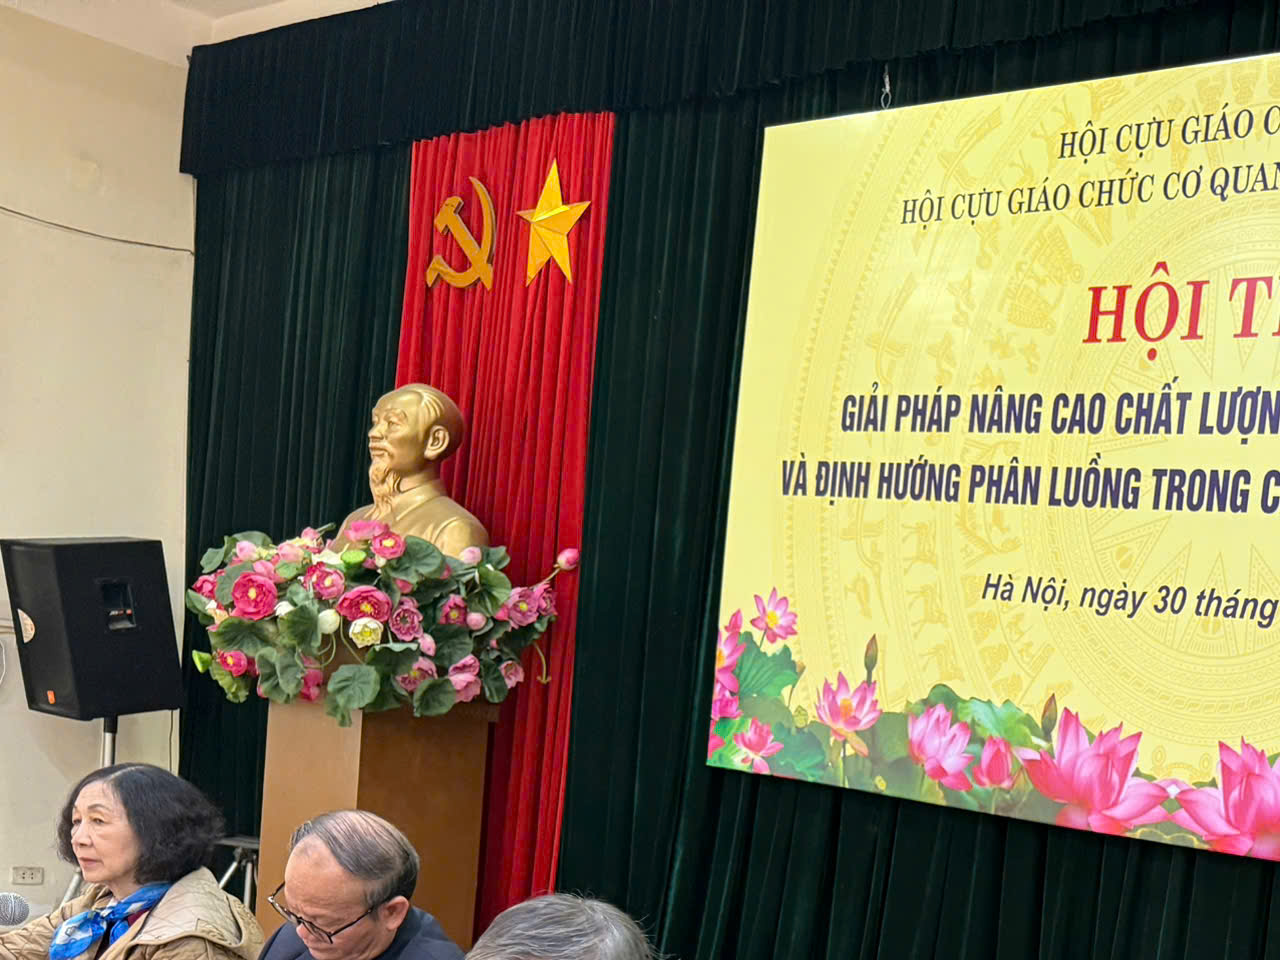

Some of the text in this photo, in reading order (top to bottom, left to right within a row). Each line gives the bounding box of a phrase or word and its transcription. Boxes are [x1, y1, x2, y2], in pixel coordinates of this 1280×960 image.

[1058, 120, 1108, 164] HỘI
[1116, 117, 1174, 158] CỰU
[1182, 103, 1253, 144] GIÁO
[901, 190, 944, 229] HỘI
[952, 188, 1002, 225] CỰU
[1008, 177, 1070, 214] GIÁO
[1079, 168, 1154, 208] CHỨC
[1163, 165, 1203, 200] CƠ
[1083, 261, 1210, 360] HỘI
[841, 382, 888, 432] GIẢI
[895, 386, 961, 432] PHÁP
[968, 385, 1042, 434] NÂNG
[1051, 393, 1106, 434] CAO
[1115, 376, 1192, 435] CHẤT
[783, 453, 807, 496] VÀ
[815, 461, 871, 505] ĐỊNH
[877, 455, 961, 502] HƯỚNG
[968, 457, 1041, 505] PHÂN
[1048, 453, 1141, 509] LUỒNG
[1152, 469, 1251, 513] TRONG
[981, 573, 1015, 602] Hà
[1022, 576, 1069, 611] Nội,
[1080, 582, 1147, 618] ngày
[1154, 585, 1187, 614] 30
[1195, 588, 1279, 628] tháng
